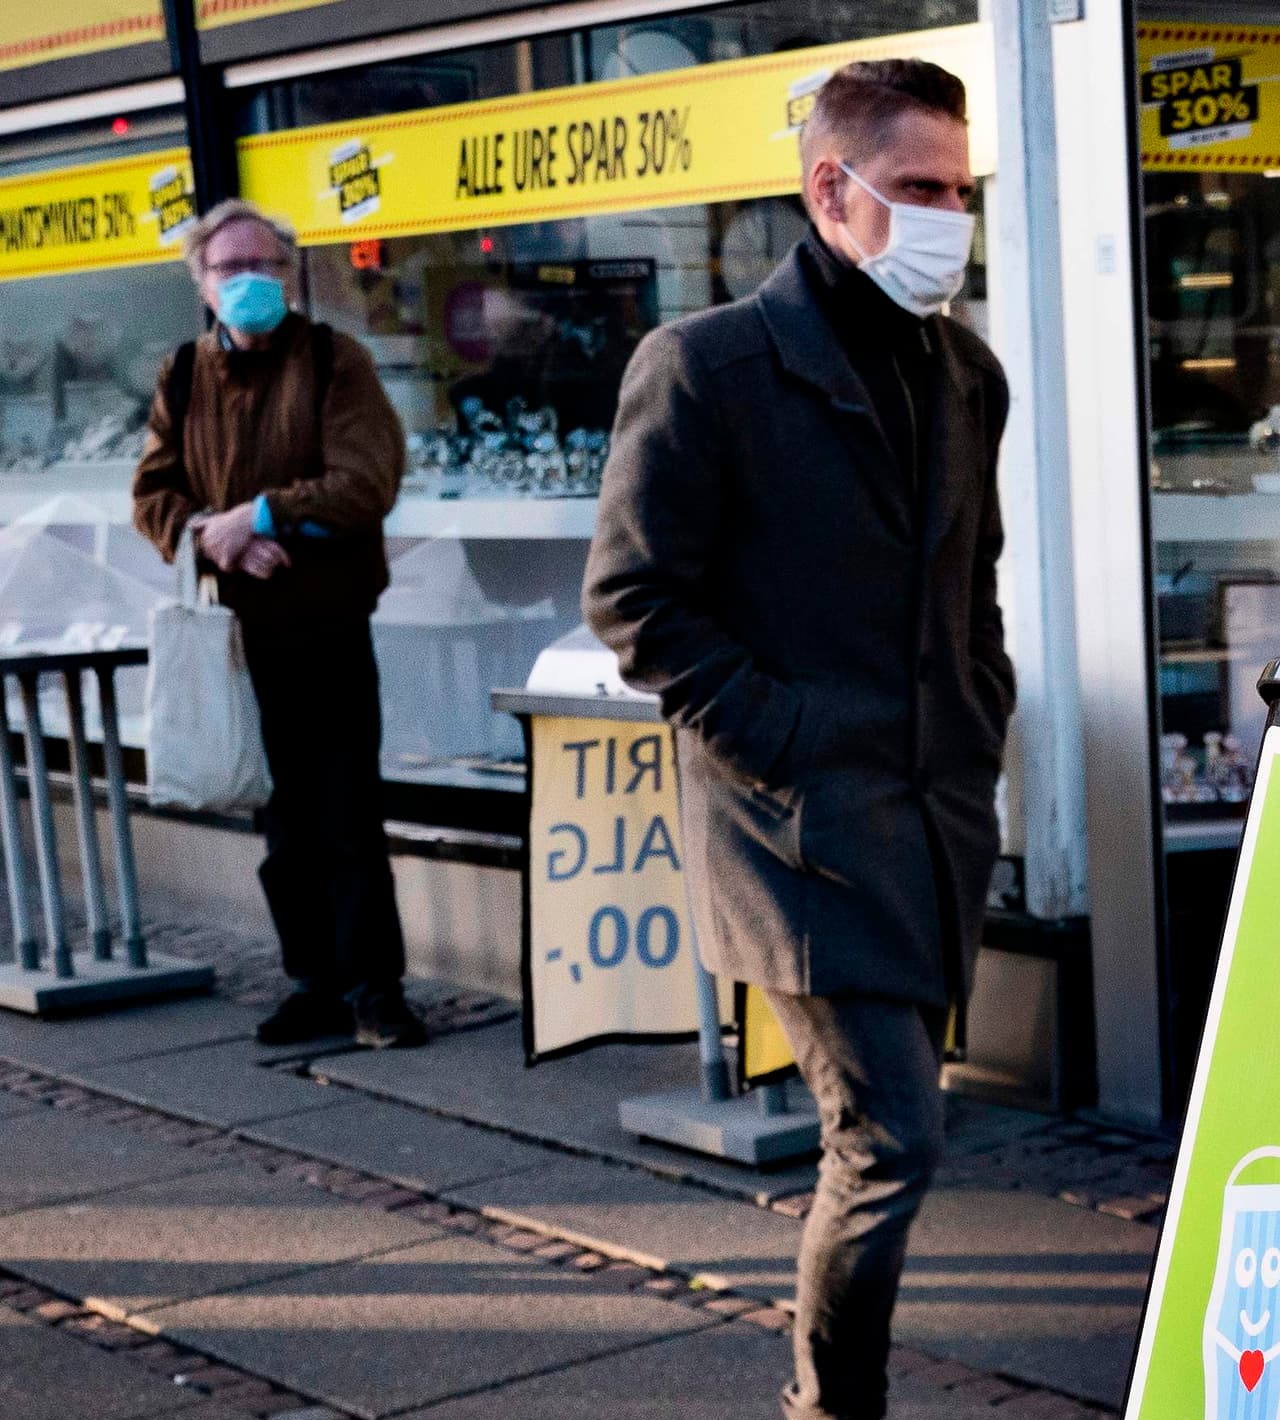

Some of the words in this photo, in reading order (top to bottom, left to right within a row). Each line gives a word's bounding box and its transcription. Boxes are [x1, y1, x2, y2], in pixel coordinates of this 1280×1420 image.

[1151, 64, 1232, 98] SPAR
[1171, 90, 1249, 129] 30%
[456, 134, 504, 198] ALLE
[513, 125, 558, 191] URE
[567, 116, 628, 185] SPAR
[637, 104, 692, 174] 30%
